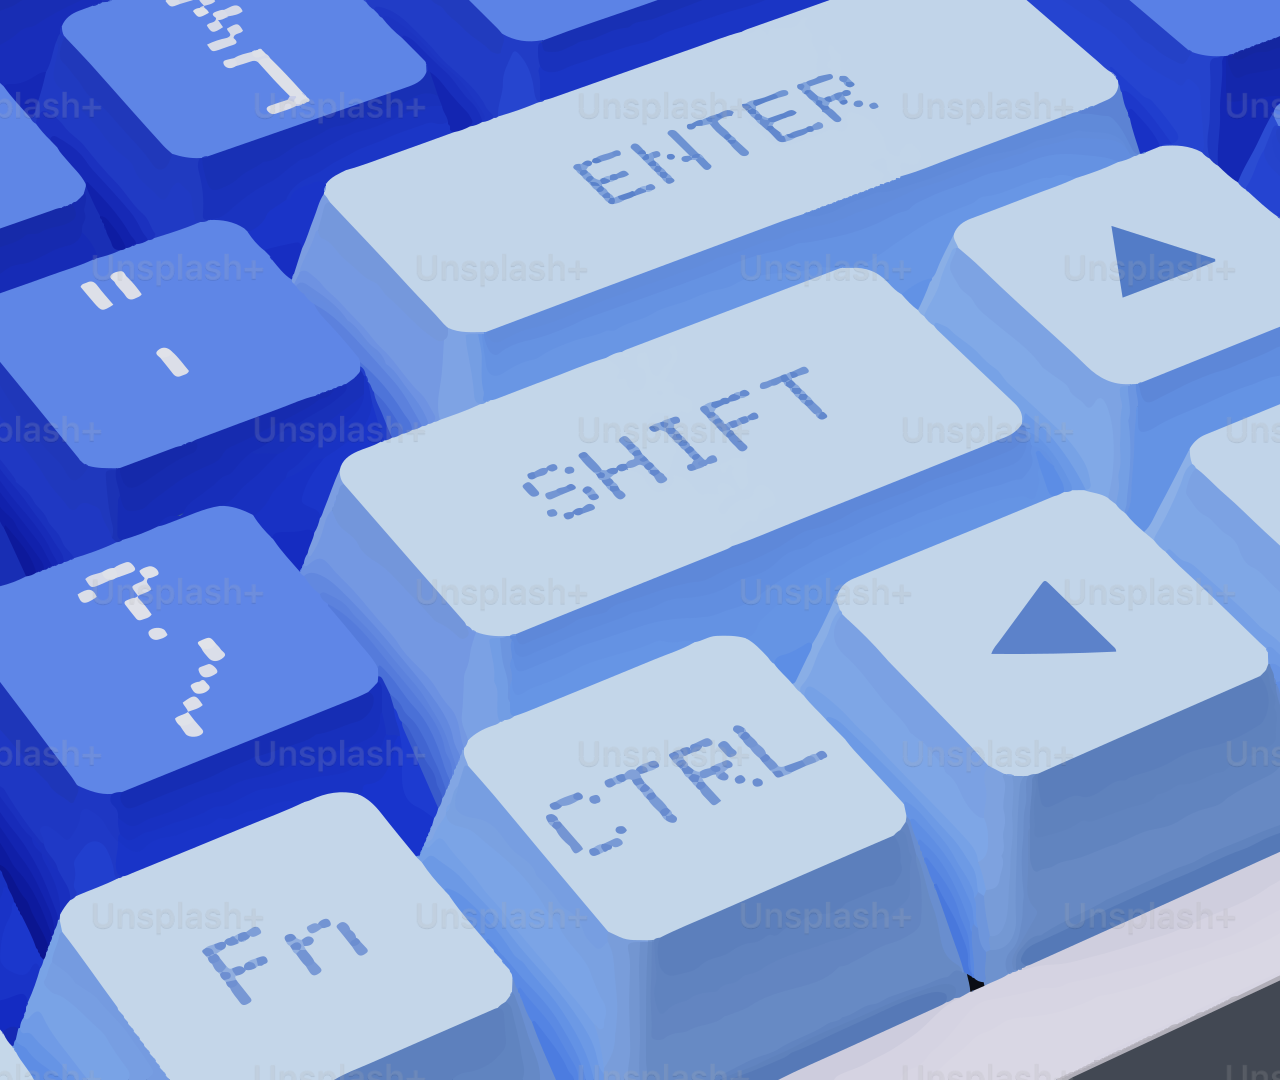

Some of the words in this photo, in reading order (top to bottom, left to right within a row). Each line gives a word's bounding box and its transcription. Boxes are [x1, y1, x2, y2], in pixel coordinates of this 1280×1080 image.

[572, 72, 880, 205] ENTER
[522, 366, 829, 521] SHIFT
[545, 724, 828, 856] CTRL
[201, 918, 369, 1006] Fn
